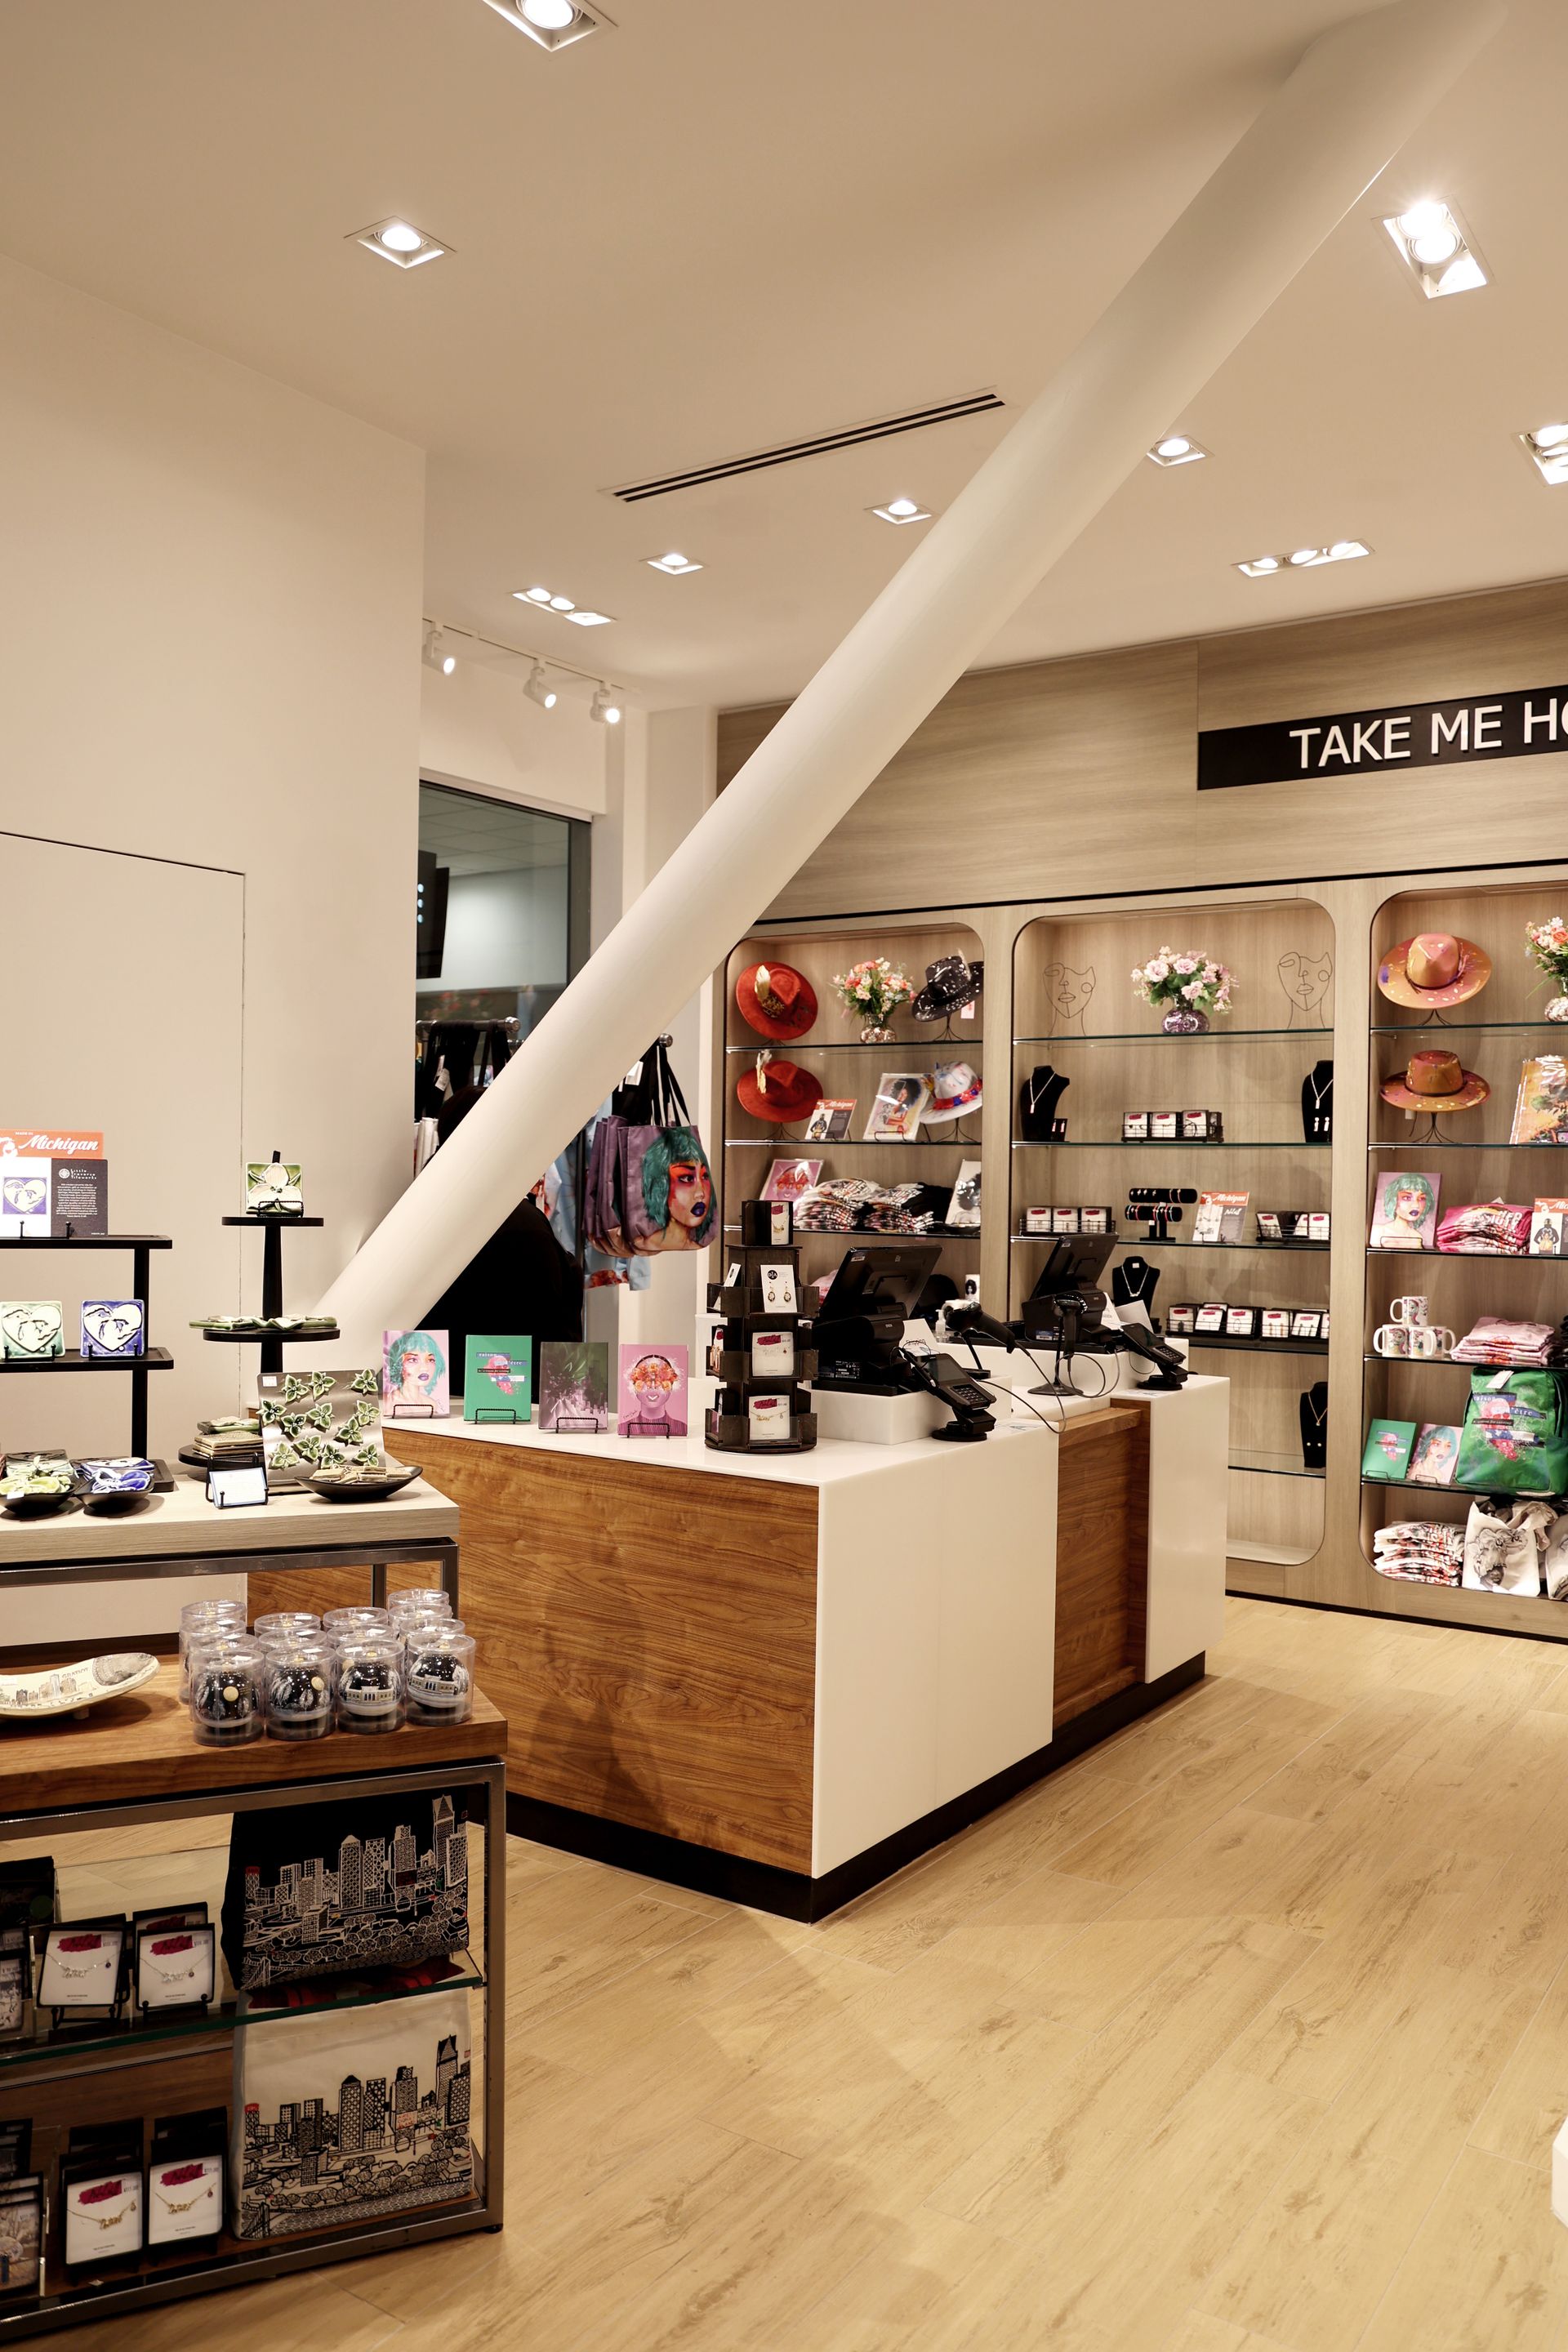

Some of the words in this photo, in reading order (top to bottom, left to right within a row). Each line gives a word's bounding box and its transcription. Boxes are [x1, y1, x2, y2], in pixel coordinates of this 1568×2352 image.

[1289, 715, 1411, 769] TAKE
[1431, 705, 1503, 755] ME
[1524, 697, 1568, 744] H
[19, 1134, 99, 1156] Michigan
[1213, 1194, 1246, 1204] Michigan
